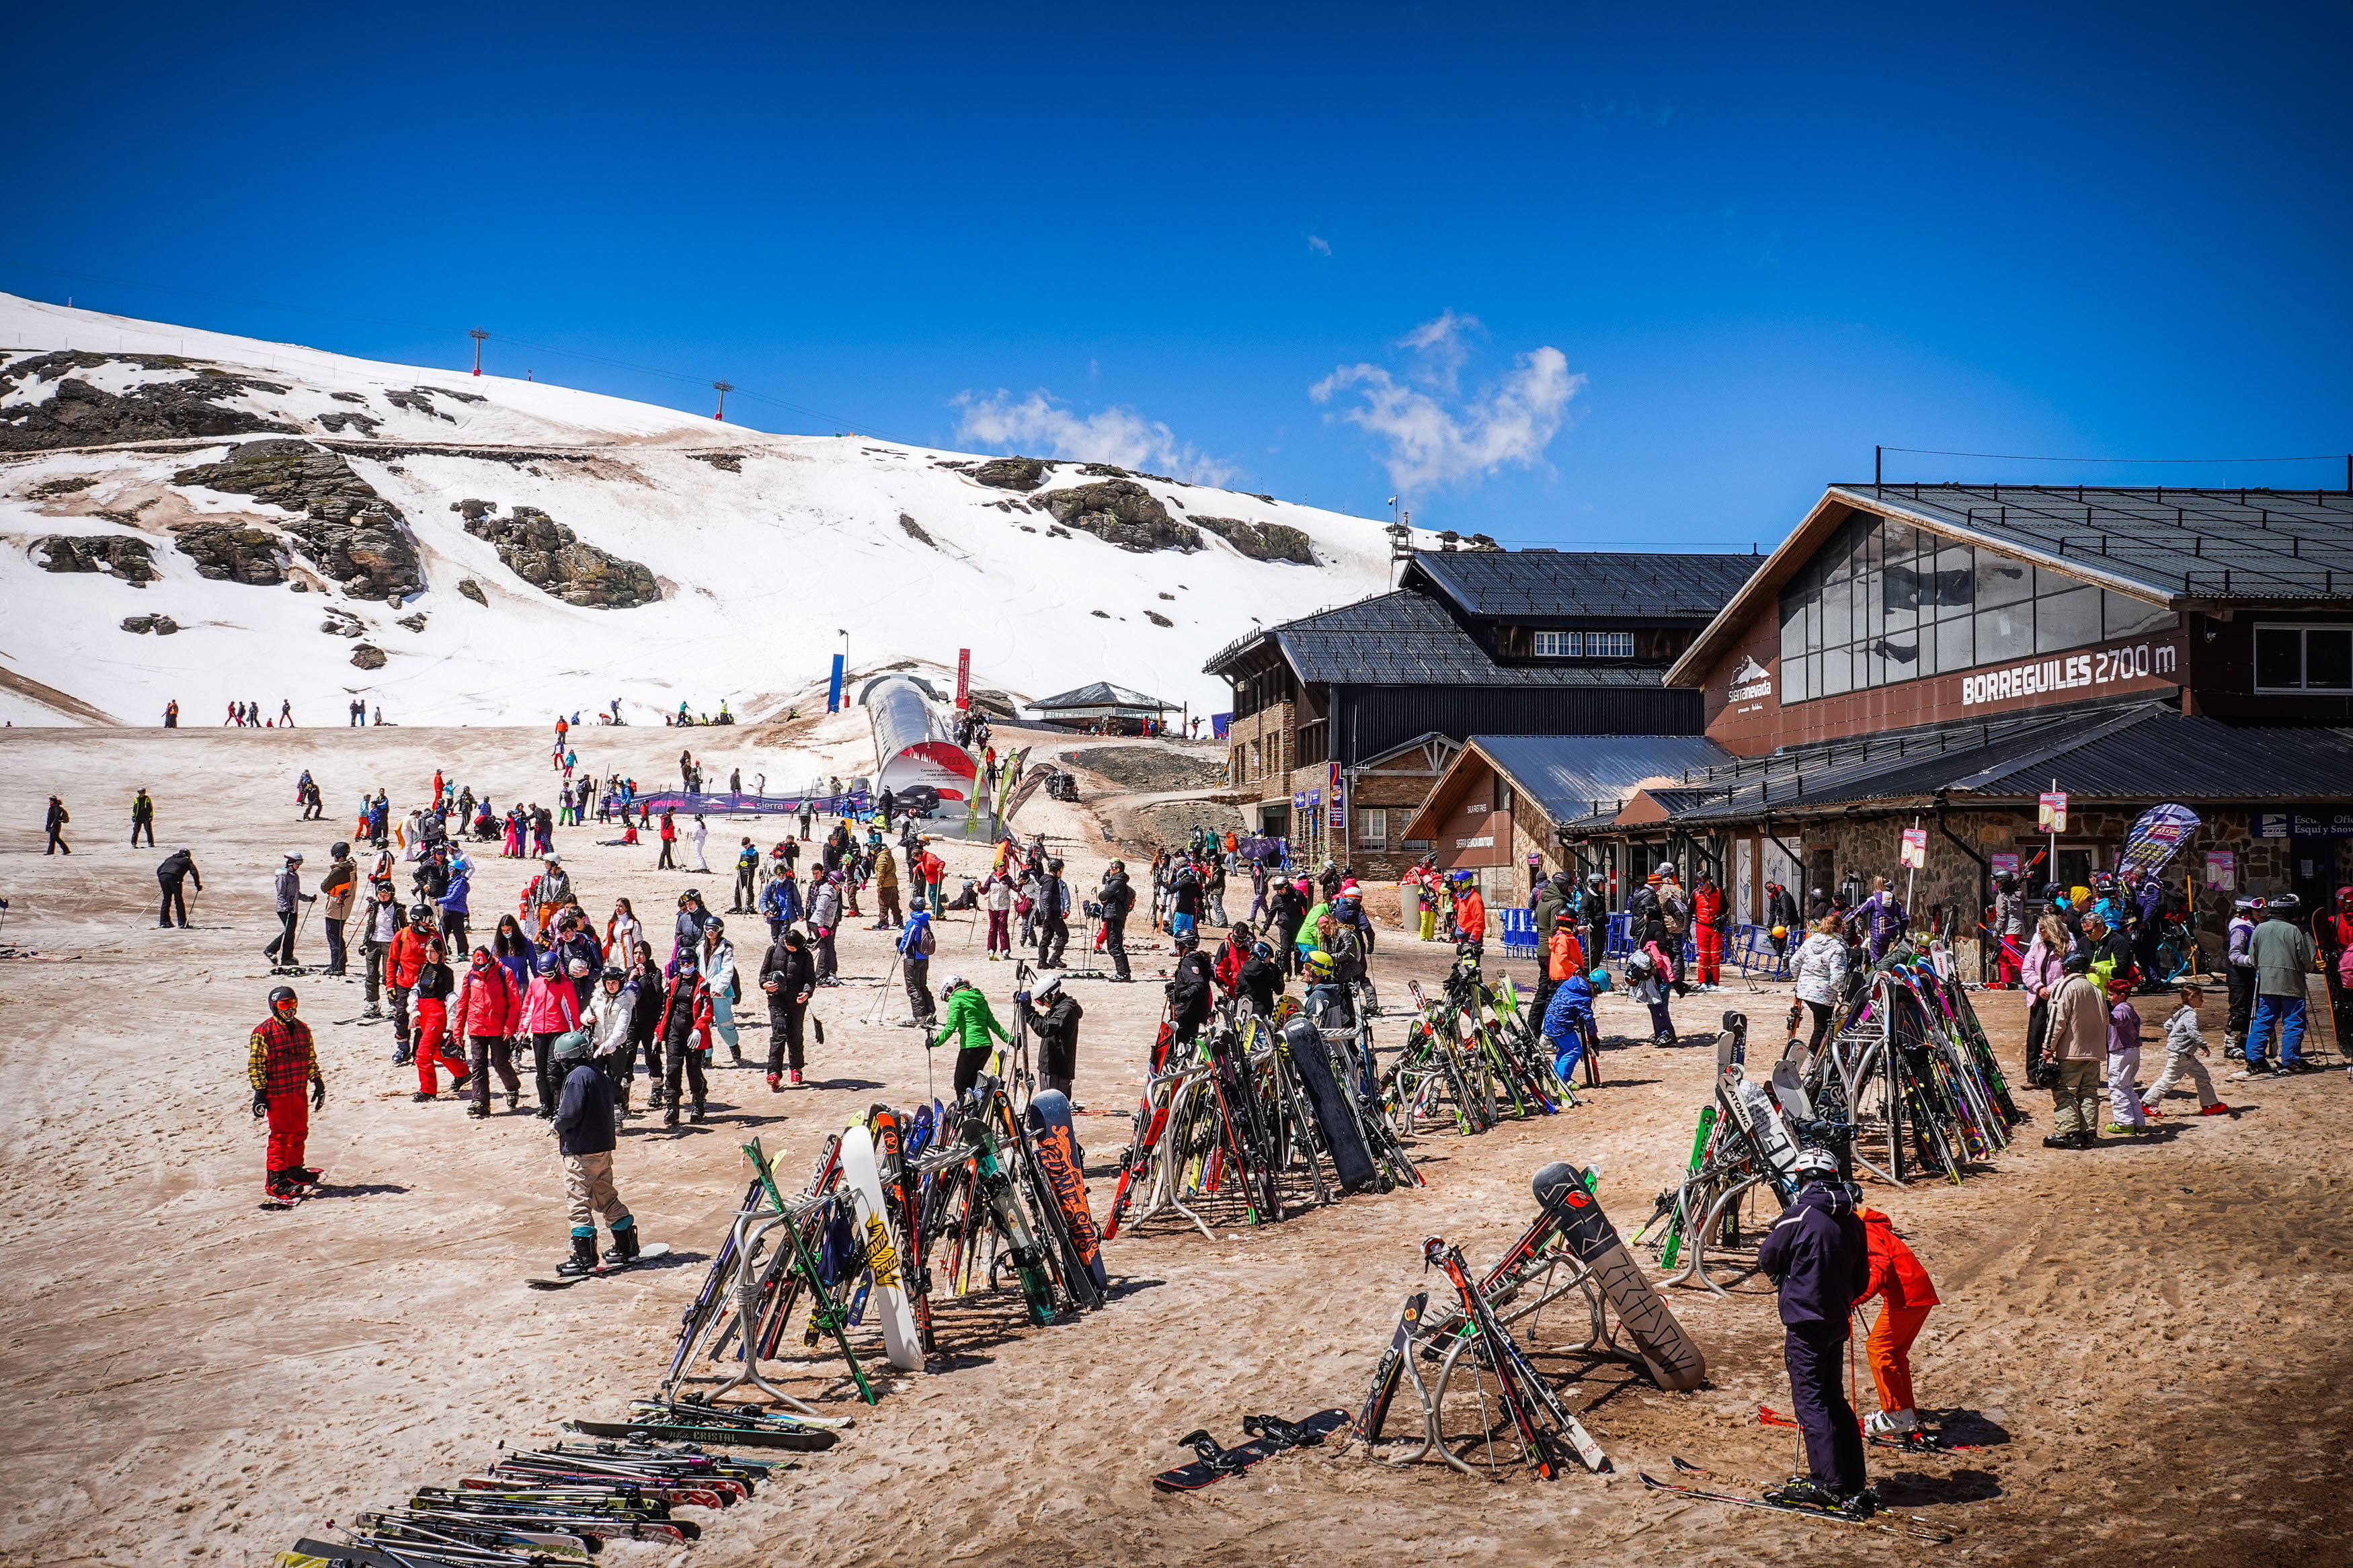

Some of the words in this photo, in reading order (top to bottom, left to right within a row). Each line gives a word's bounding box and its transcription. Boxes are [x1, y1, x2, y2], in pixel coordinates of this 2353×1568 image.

[960, 660, 965, 669] de
[1962, 655, 2091, 706] BORREGUILES
[2095, 644, 2151, 684] 2700
[2155, 645, 2176, 674] m
[2041, 806, 2050, 823] 7
[2054, 813, 2064, 831] 8
[2295, 815, 2319, 824] Escu
[2295, 825, 2321, 835] Esquí
[2323, 827, 2329, 835] y
[1903, 840, 1912, 857] 9
[1913, 852, 1921, 867] 0
[2207, 864, 2217, 882] 1
[2223, 872, 2233, 889] 2
[1287, 1022, 1305, 1032] NITRO
[1729, 1090, 1751, 1128] ATOMIC
[867, 1231, 888, 1260] SANTA
[875, 1255, 898, 1278] CRUZ
[693, 1431, 738, 1442] CRISTAL
